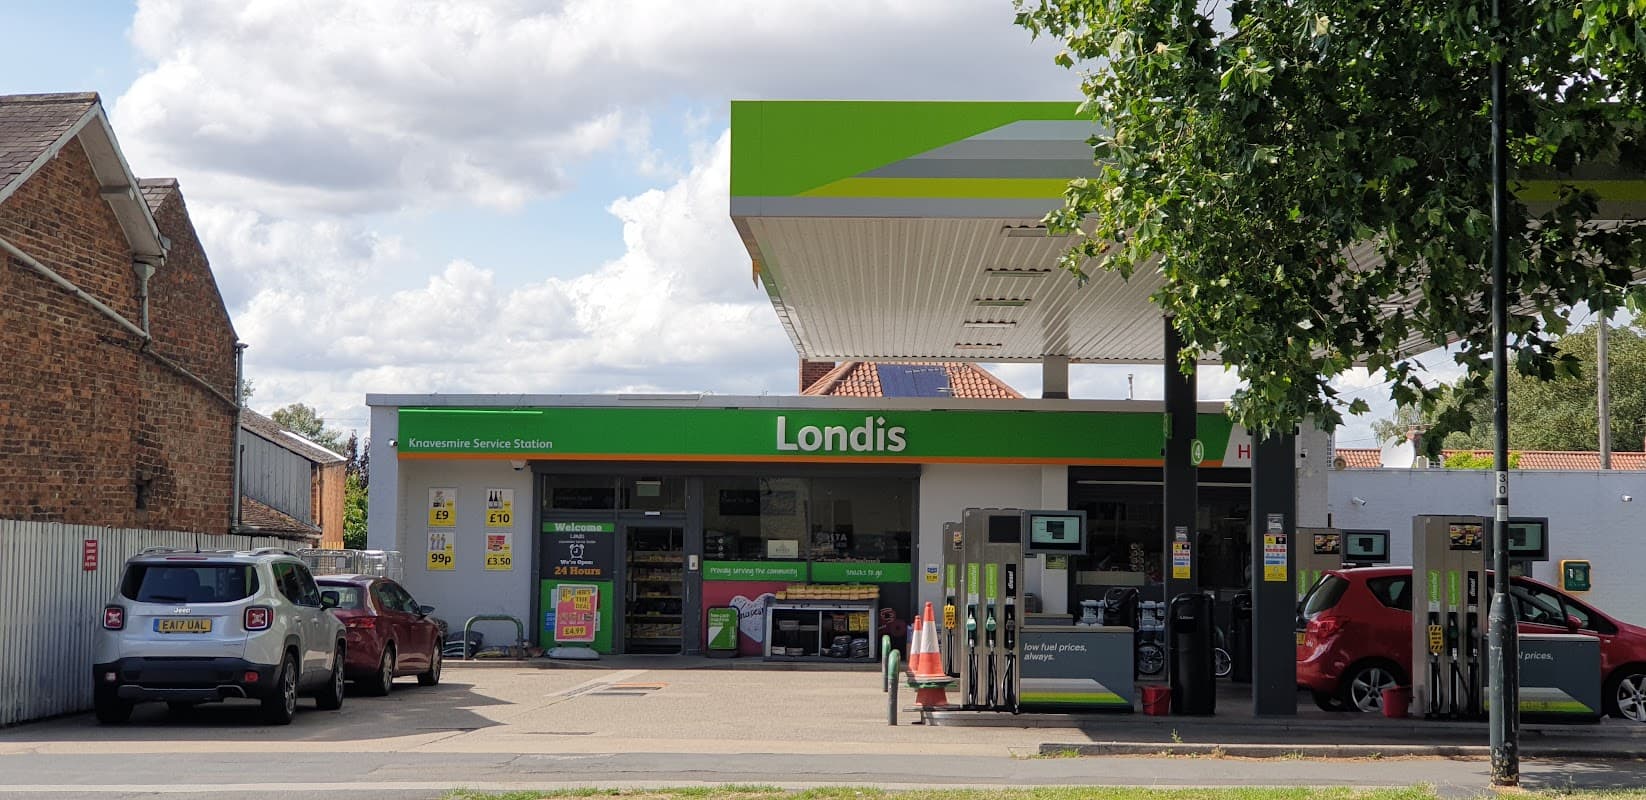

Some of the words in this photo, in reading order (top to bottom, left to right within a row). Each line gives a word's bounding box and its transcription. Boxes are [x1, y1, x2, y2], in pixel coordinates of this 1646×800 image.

[777, 416, 907, 452] Londis
[408, 437, 470, 448] Knavesmire
[473, 438, 511, 449] Service
[513, 438, 553, 449] Station
[1195, 444, 1201, 459] 4
[435, 510, 449, 520] £9
[489, 513, 510, 523] £10
[554, 522, 602, 532] Welcome
[431, 553, 452, 566] 99p
[487, 557, 511, 566] £3.50
[554, 566, 568, 575] 24
[570, 566, 601, 575] Hours
[162, 620, 185, 630] EA17
[187, 619, 207, 630] UAL
[565, 626, 584, 635] £4.99
[1024, 643, 1039, 651] low
[1041, 643, 1057, 651] fuel
[1058, 643, 1087, 653] prices,
[1525, 651, 1554, 661] prices,
